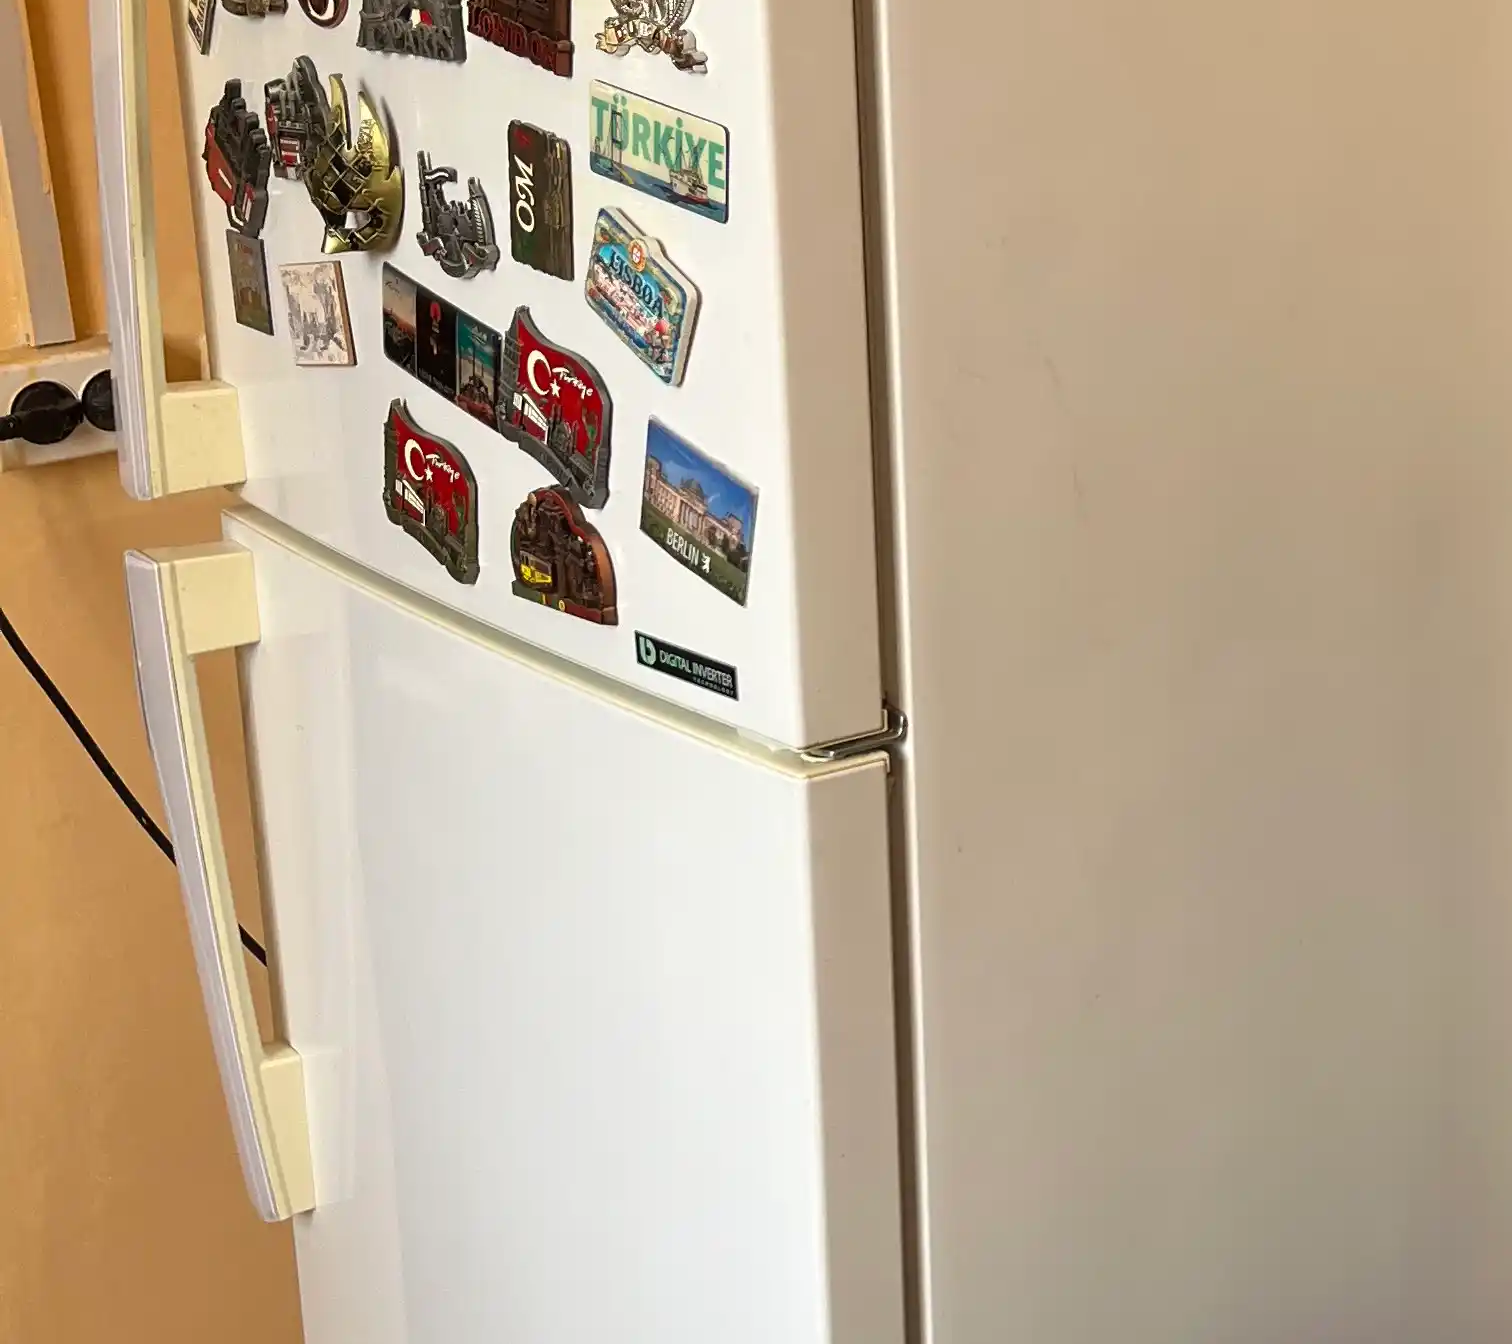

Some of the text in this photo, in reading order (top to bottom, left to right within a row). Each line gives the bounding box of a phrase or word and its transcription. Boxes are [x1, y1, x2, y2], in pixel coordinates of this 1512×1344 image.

[471, 5, 557, 74] LONDON
[591, 92, 725, 190] TÜRKİYE
[665, 527, 700, 567] BERLIN
[659, 649, 734, 690] DIGITAL INVERTER
